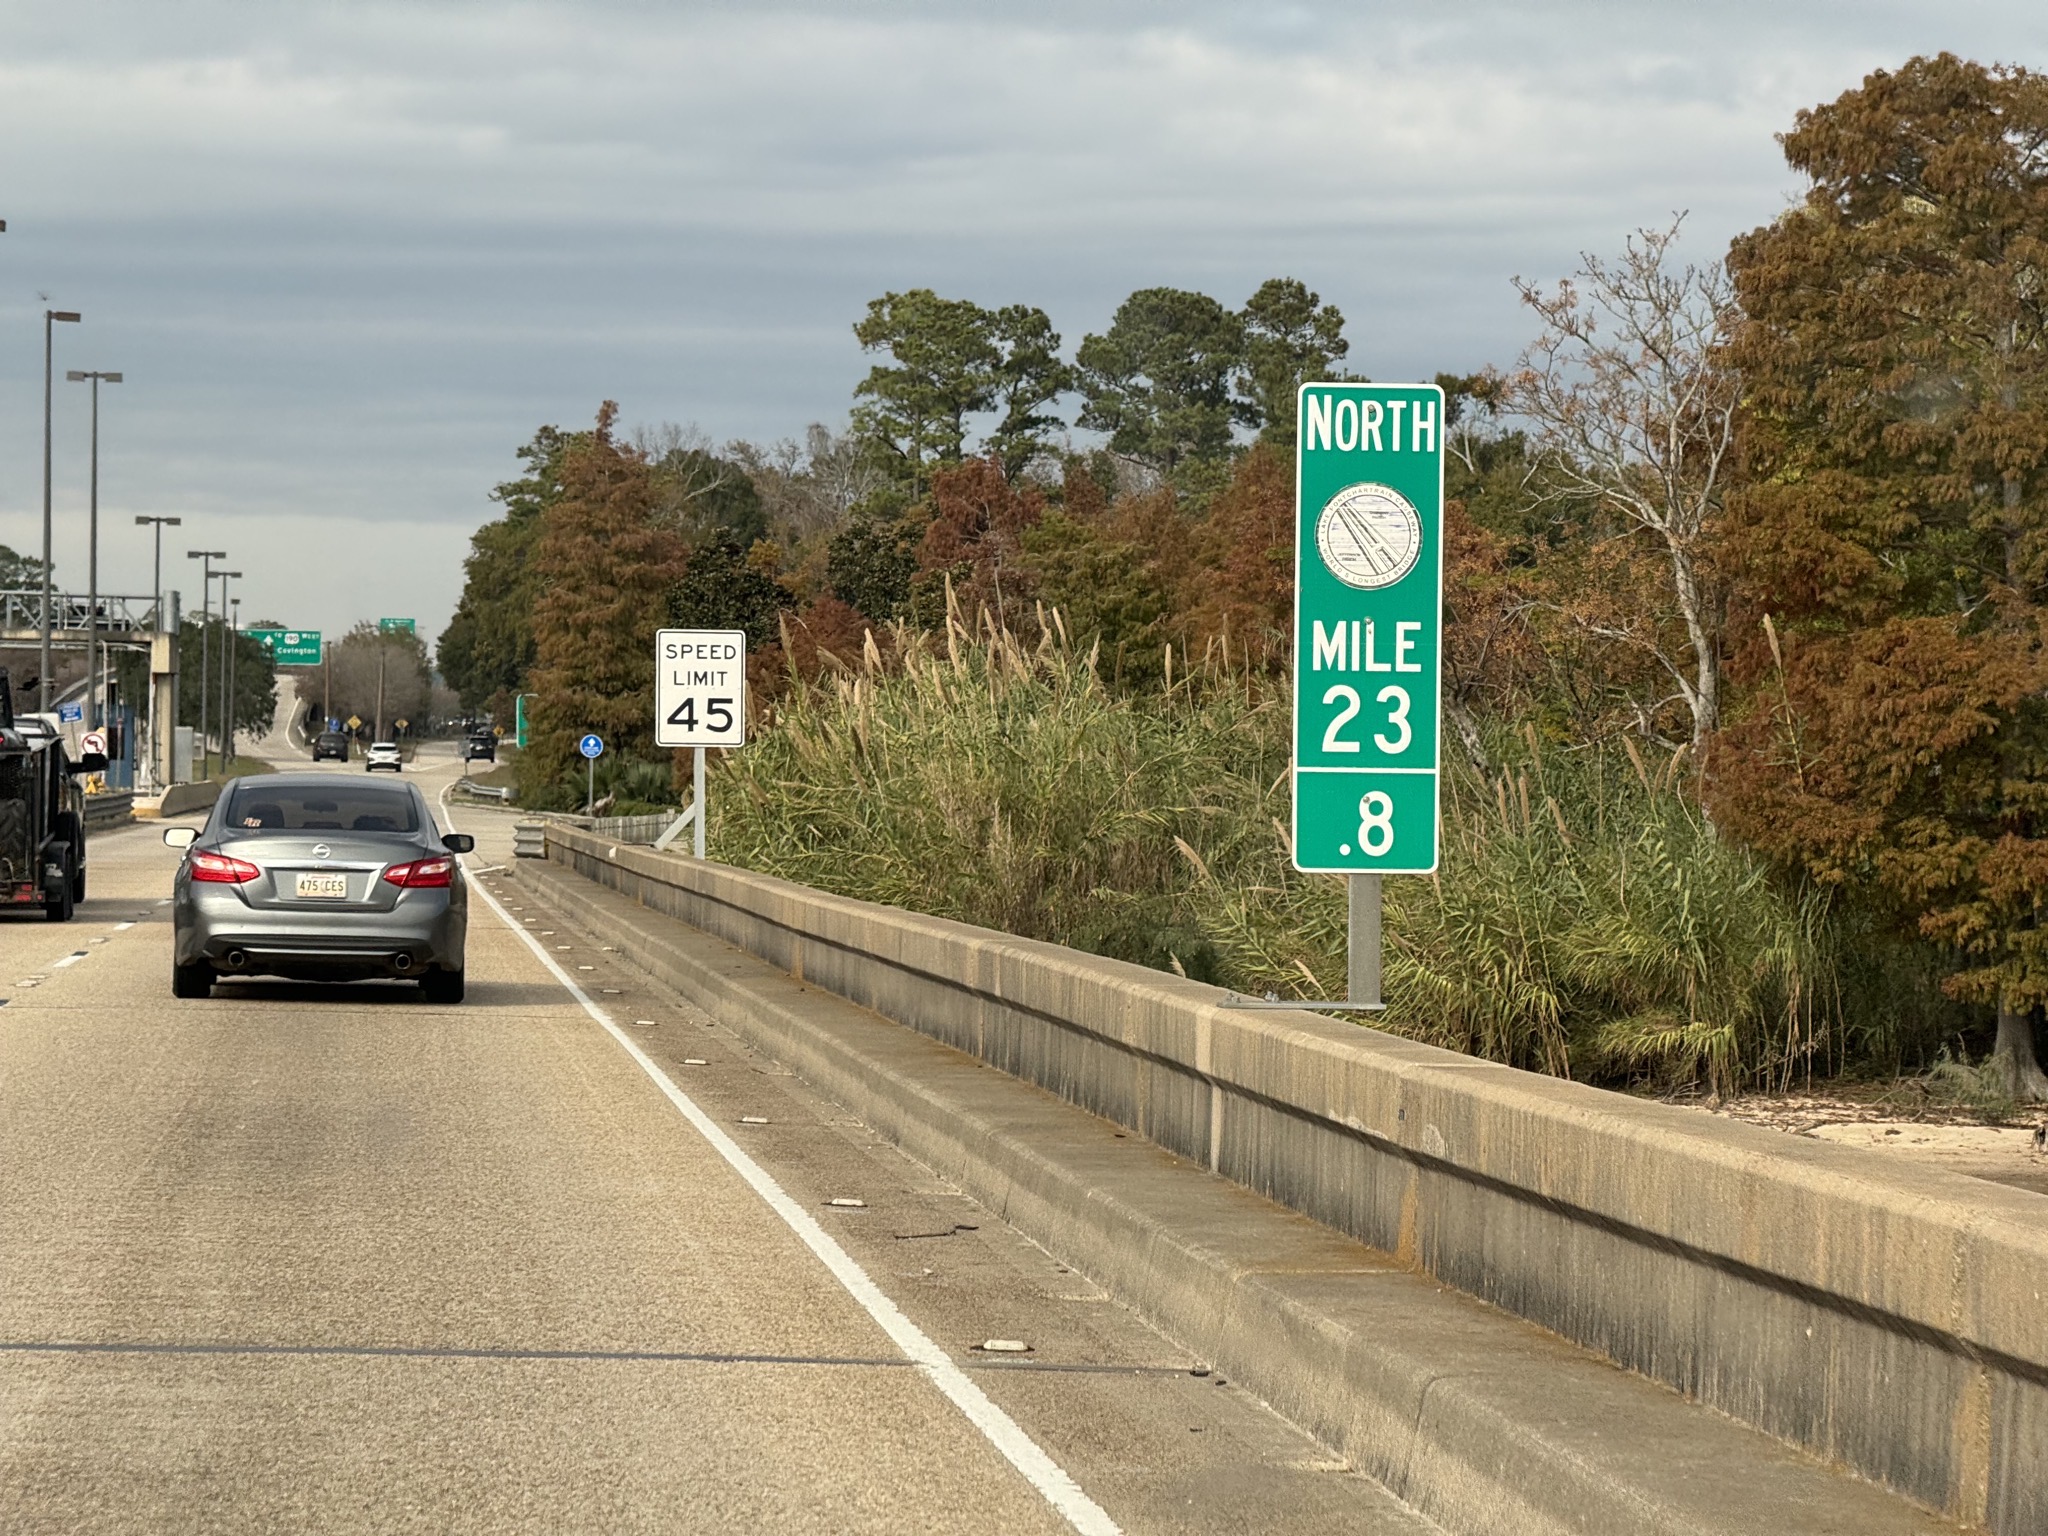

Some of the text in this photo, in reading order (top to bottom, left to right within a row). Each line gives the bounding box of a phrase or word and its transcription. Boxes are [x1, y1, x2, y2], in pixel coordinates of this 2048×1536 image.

[1307, 394, 1436, 453] NORTH
[1321, 487, 1418, 538] LAKE PONTCHARTRAIN CAUSEWAY
[1322, 547, 1413, 584] WORLDS LONGEST BRIDGE
[277, 647, 317, 656] Covington
[666, 643, 736, 660] SPEED
[1312, 620, 1422, 673] MILE
[673, 670, 728, 686] LIMIT
[667, 697, 733, 733] 45
[1321, 684, 1412, 755] 23
[1339, 790, 1394, 857] .8
[299, 880, 344, 892] 475 CES
